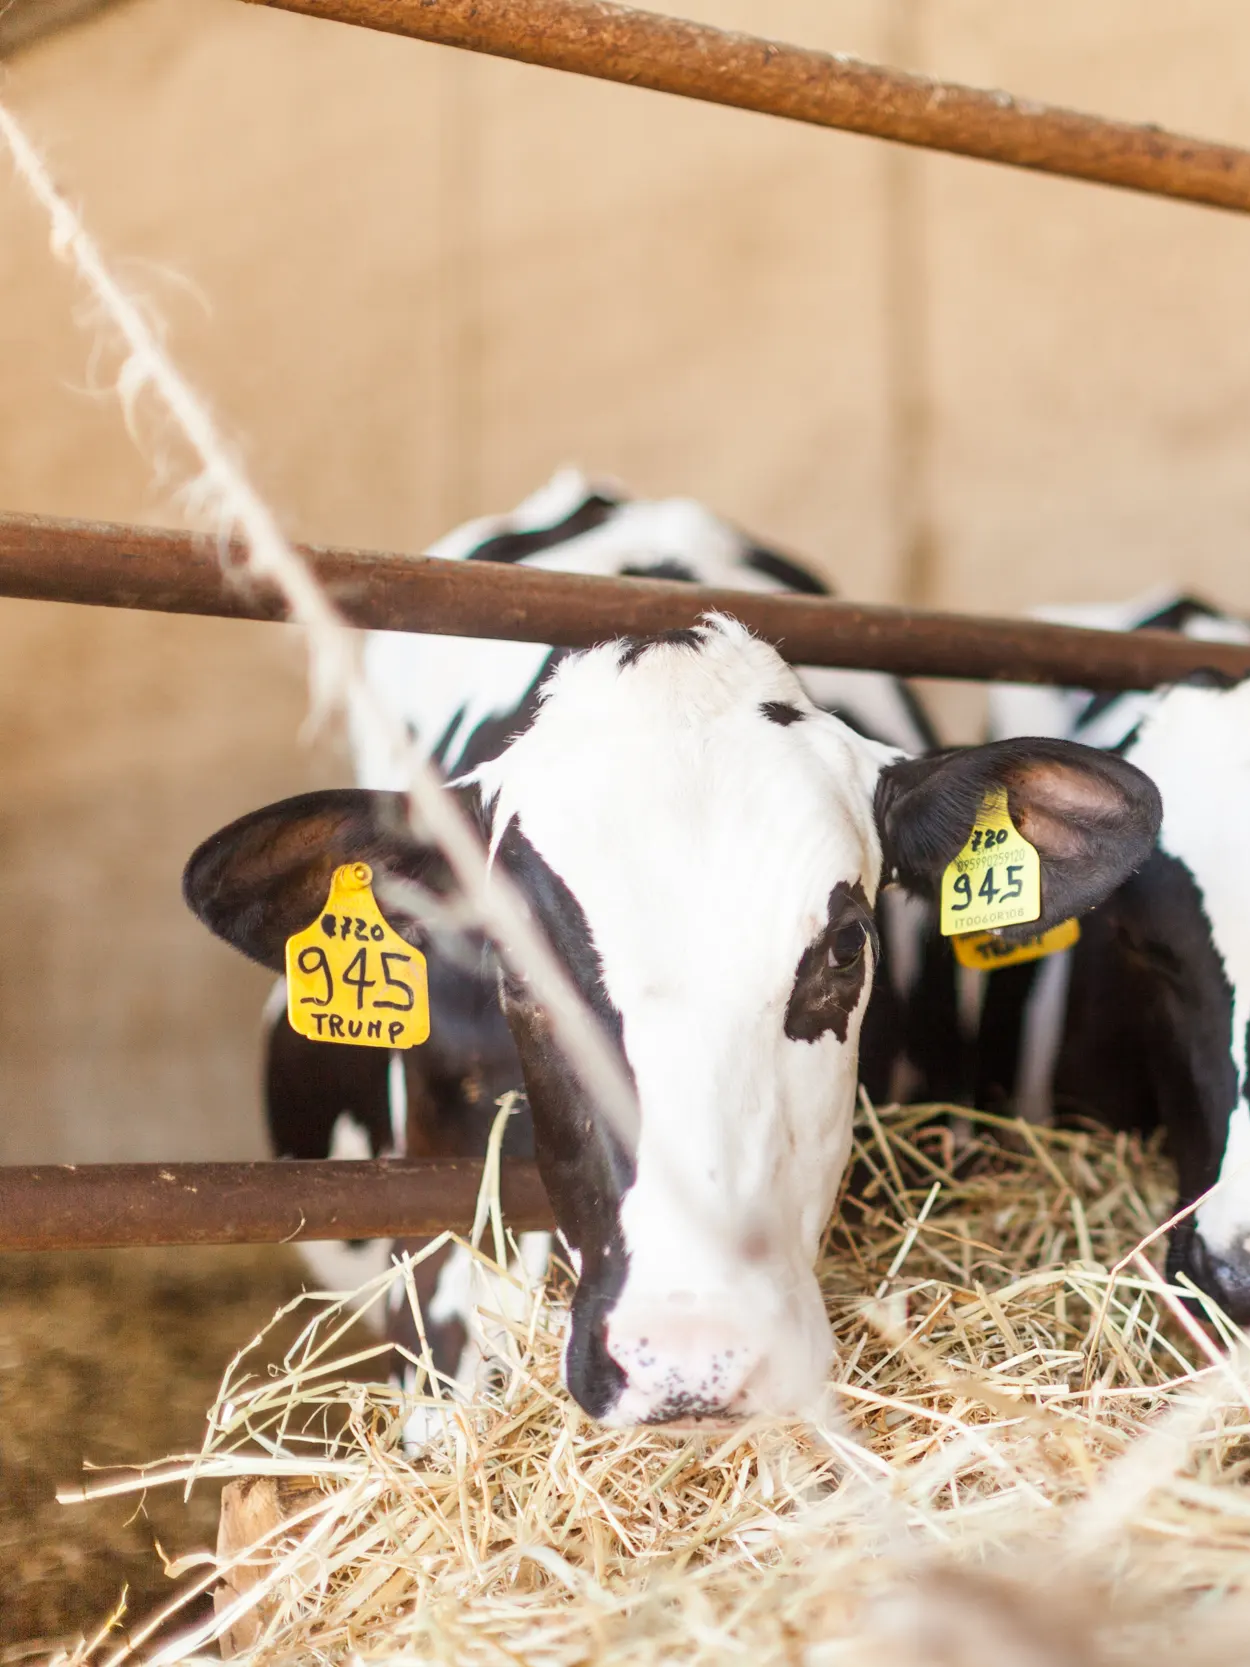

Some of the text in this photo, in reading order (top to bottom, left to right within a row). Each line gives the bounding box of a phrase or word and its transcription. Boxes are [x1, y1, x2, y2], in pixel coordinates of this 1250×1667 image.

[971, 829, 1009, 852] 720
[951, 865, 1024, 911] 945
[298, 946, 415, 1012] 945
